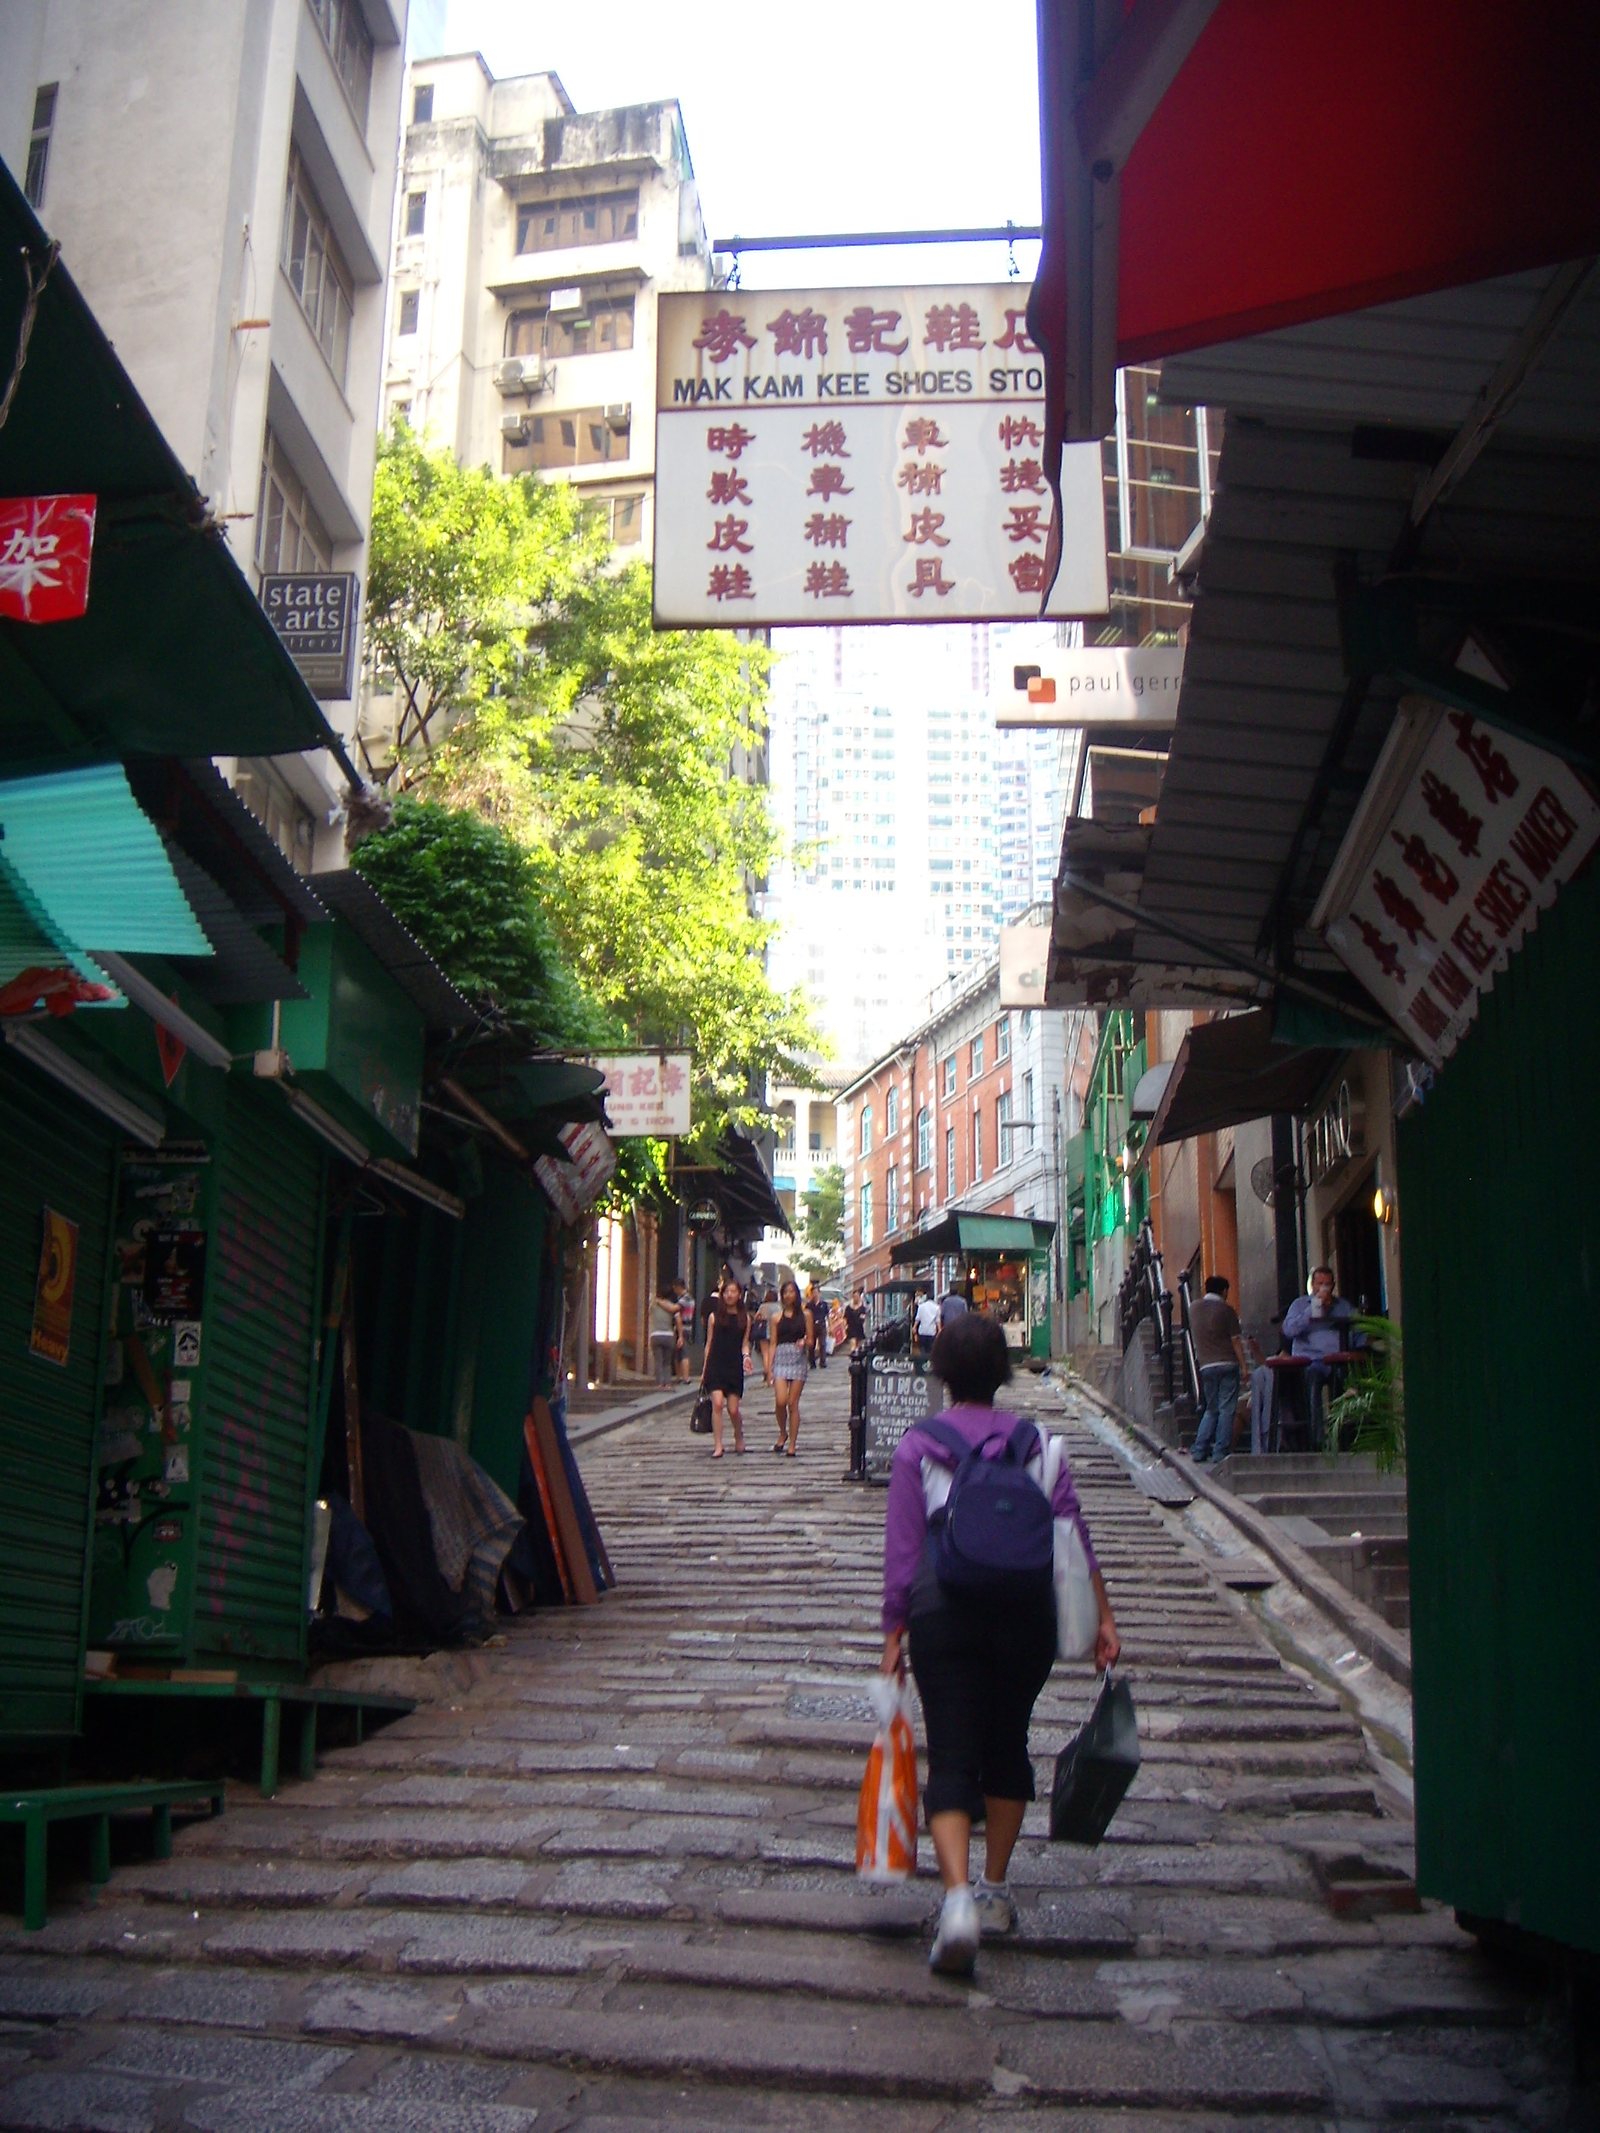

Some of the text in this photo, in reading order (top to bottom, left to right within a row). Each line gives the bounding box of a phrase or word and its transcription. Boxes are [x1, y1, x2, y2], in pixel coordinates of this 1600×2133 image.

[673, 368, 1044, 403] MAK KAM KEE SHOES STO
[269, 583, 341, 606] state
[285, 607, 340, 630] arts
[1069, 672, 1120, 696] paul
[1473, 859, 1532, 939] SHOES
[1509, 786, 1579, 884] MAKER
[875, 1377, 927, 1394] LINQ
[870, 1395, 929, 1406] HAPPY HOUR
